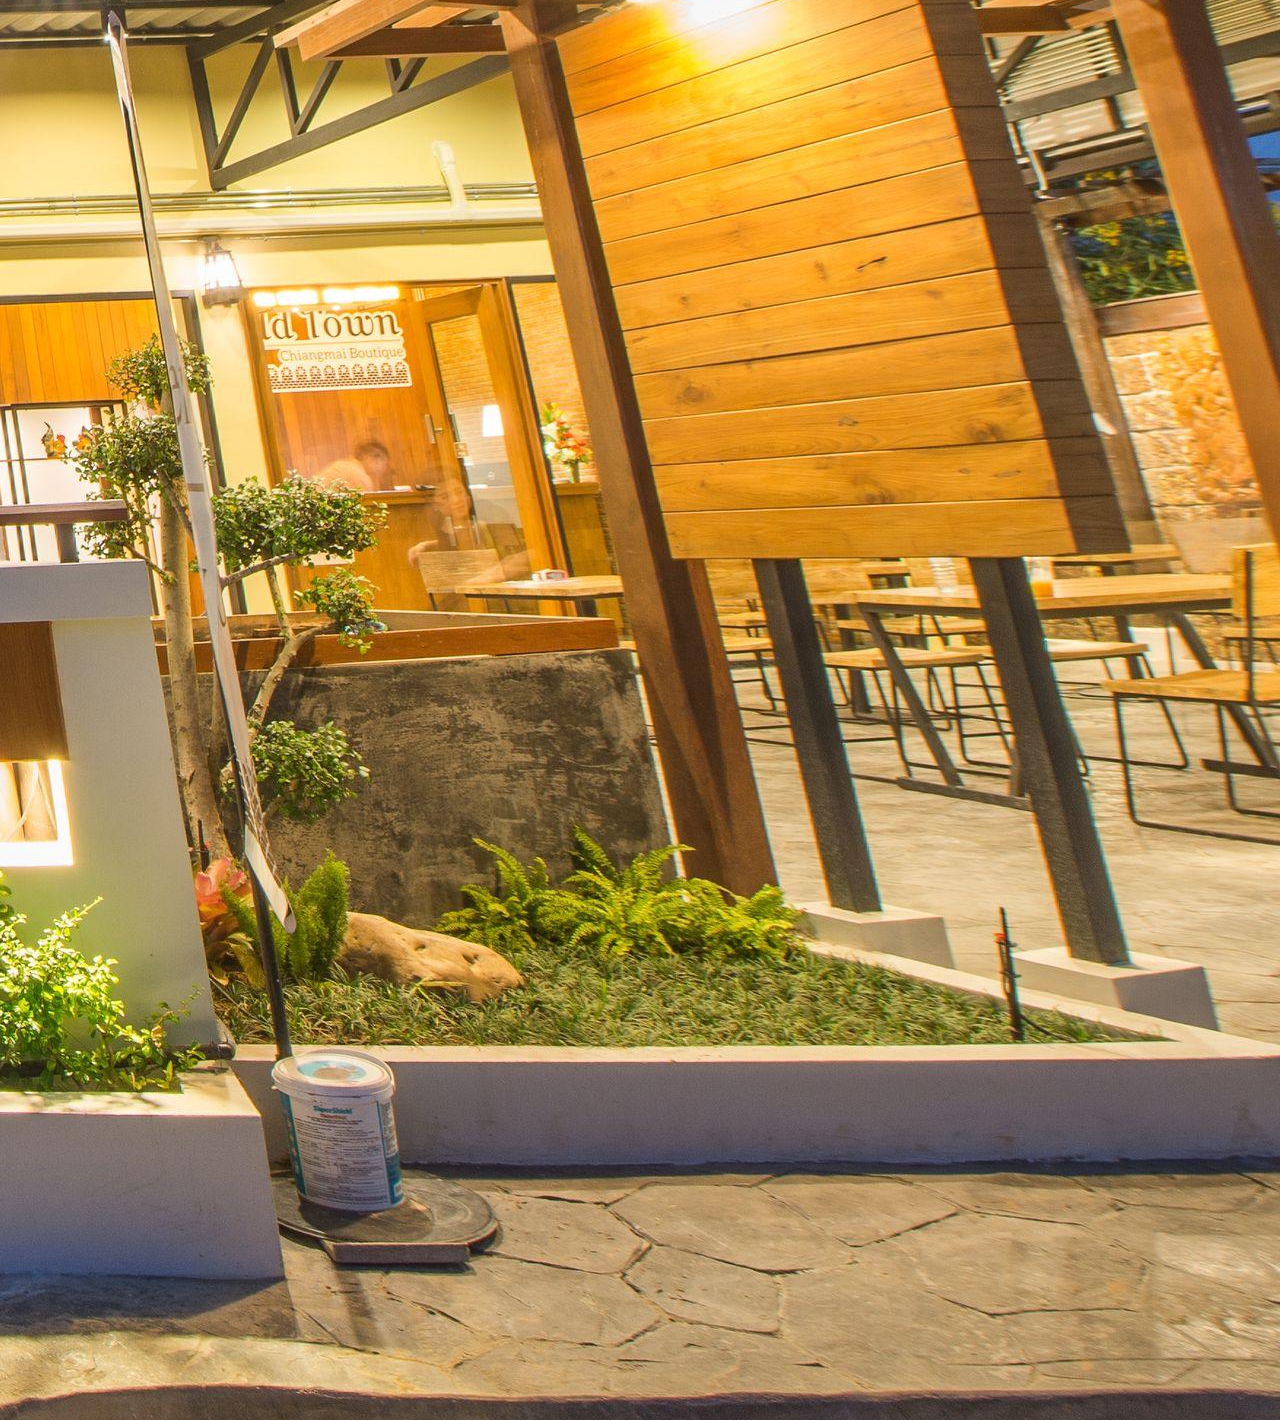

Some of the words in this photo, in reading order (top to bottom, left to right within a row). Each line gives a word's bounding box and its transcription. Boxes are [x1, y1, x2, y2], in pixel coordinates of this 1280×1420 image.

[262, 311, 296, 340] ld
[301, 310, 401, 339] Town
[280, 349, 347, 362] Chiangmai
[349, 347, 405, 360] Boutique
